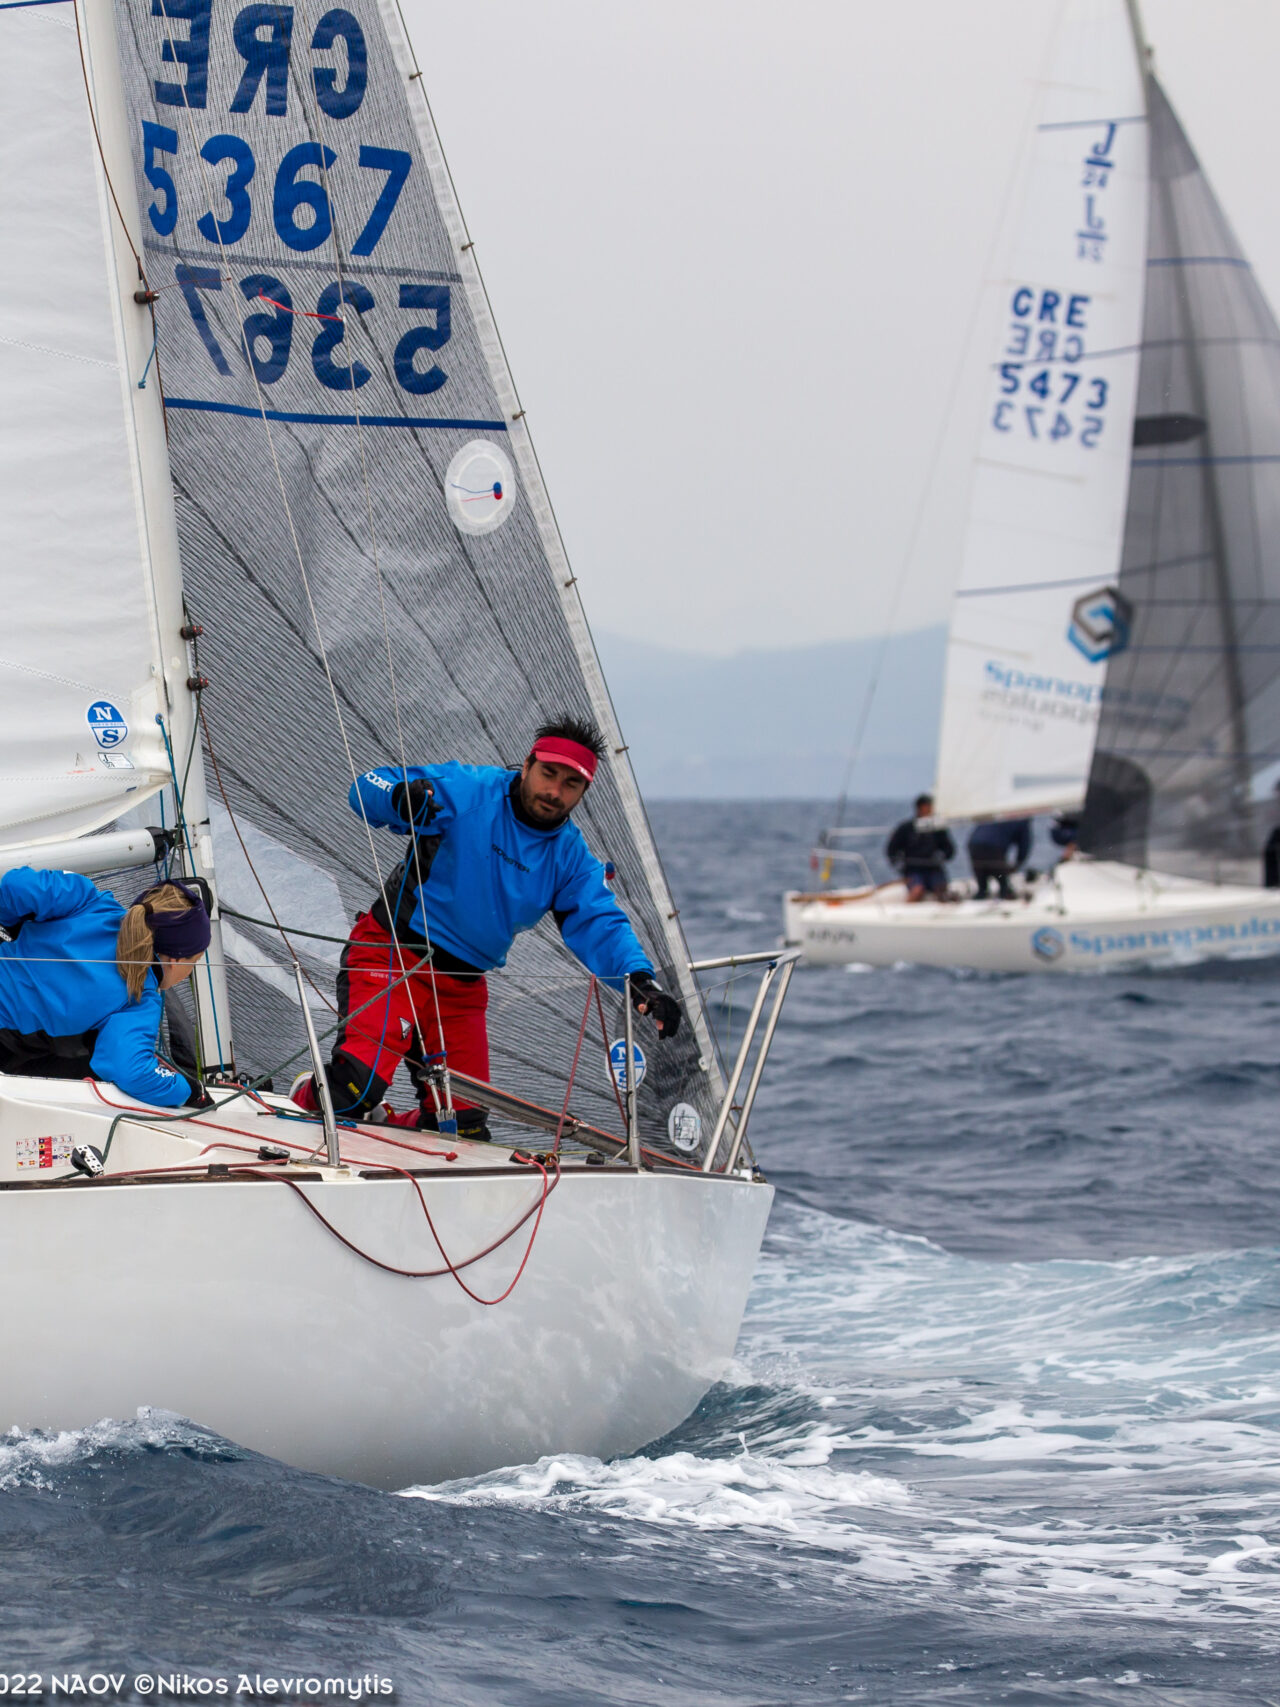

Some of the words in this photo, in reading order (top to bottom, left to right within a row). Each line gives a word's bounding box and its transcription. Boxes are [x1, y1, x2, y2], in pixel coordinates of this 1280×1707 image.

[142, 120, 412, 257] 5367
[1012, 287, 1090, 329] GRE
[999, 362, 1108, 410] 5473
[93, 707, 112, 720] N
[102, 729, 119, 743] S
